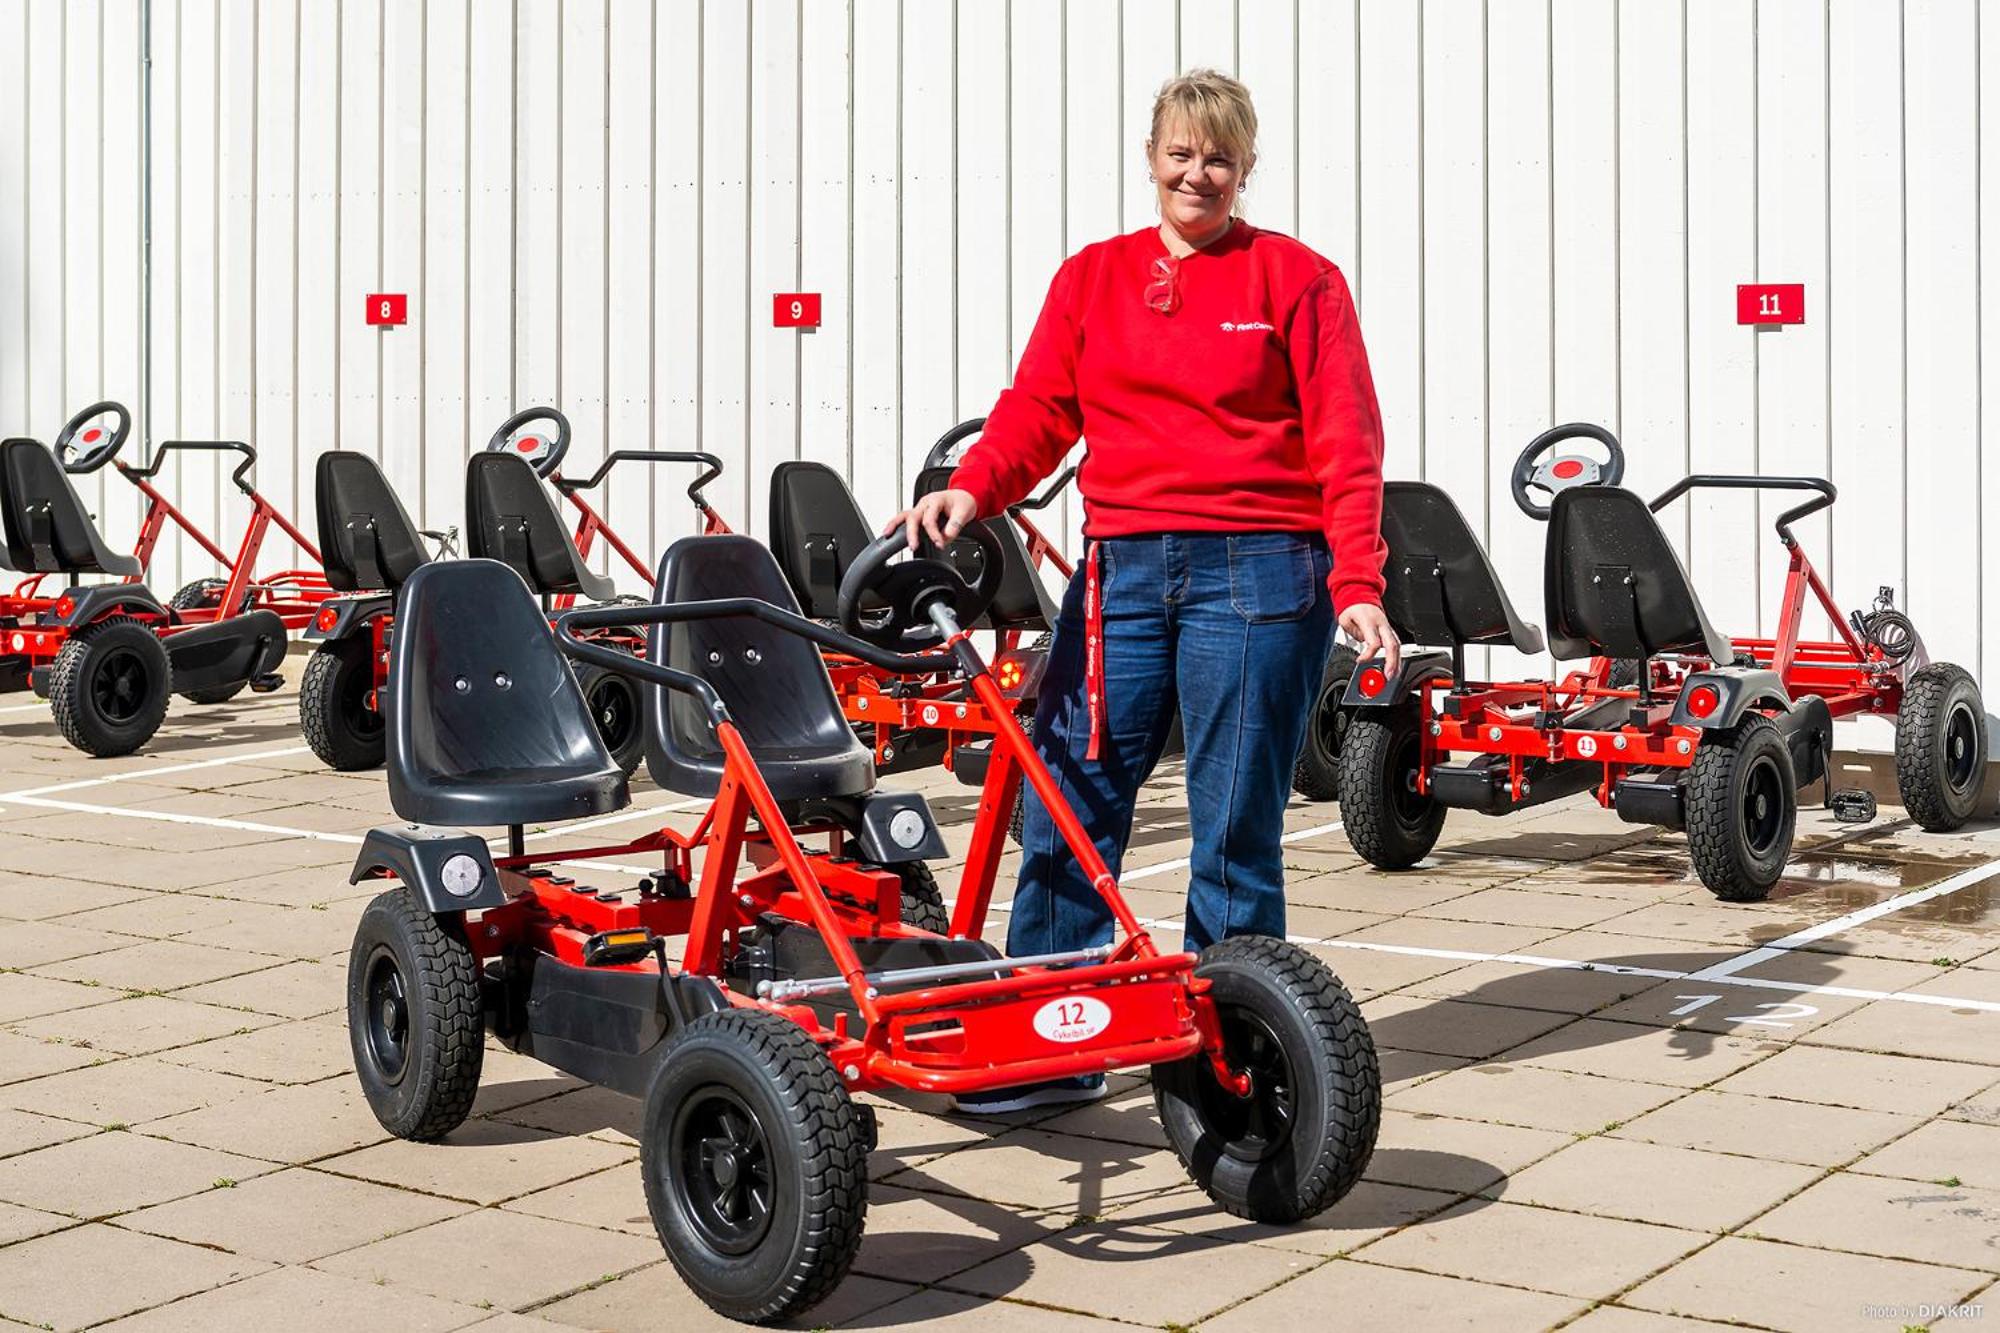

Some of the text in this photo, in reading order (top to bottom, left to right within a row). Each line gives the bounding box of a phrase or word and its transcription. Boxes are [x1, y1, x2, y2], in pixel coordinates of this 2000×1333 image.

[381, 300, 391, 319] 8
[791, 301, 802, 320] 9
[1759, 294, 1782, 315] 11
[926, 708, 937, 720] 10
[1581, 740, 1593, 751] 11
[1058, 1002, 1087, 1026] 12
